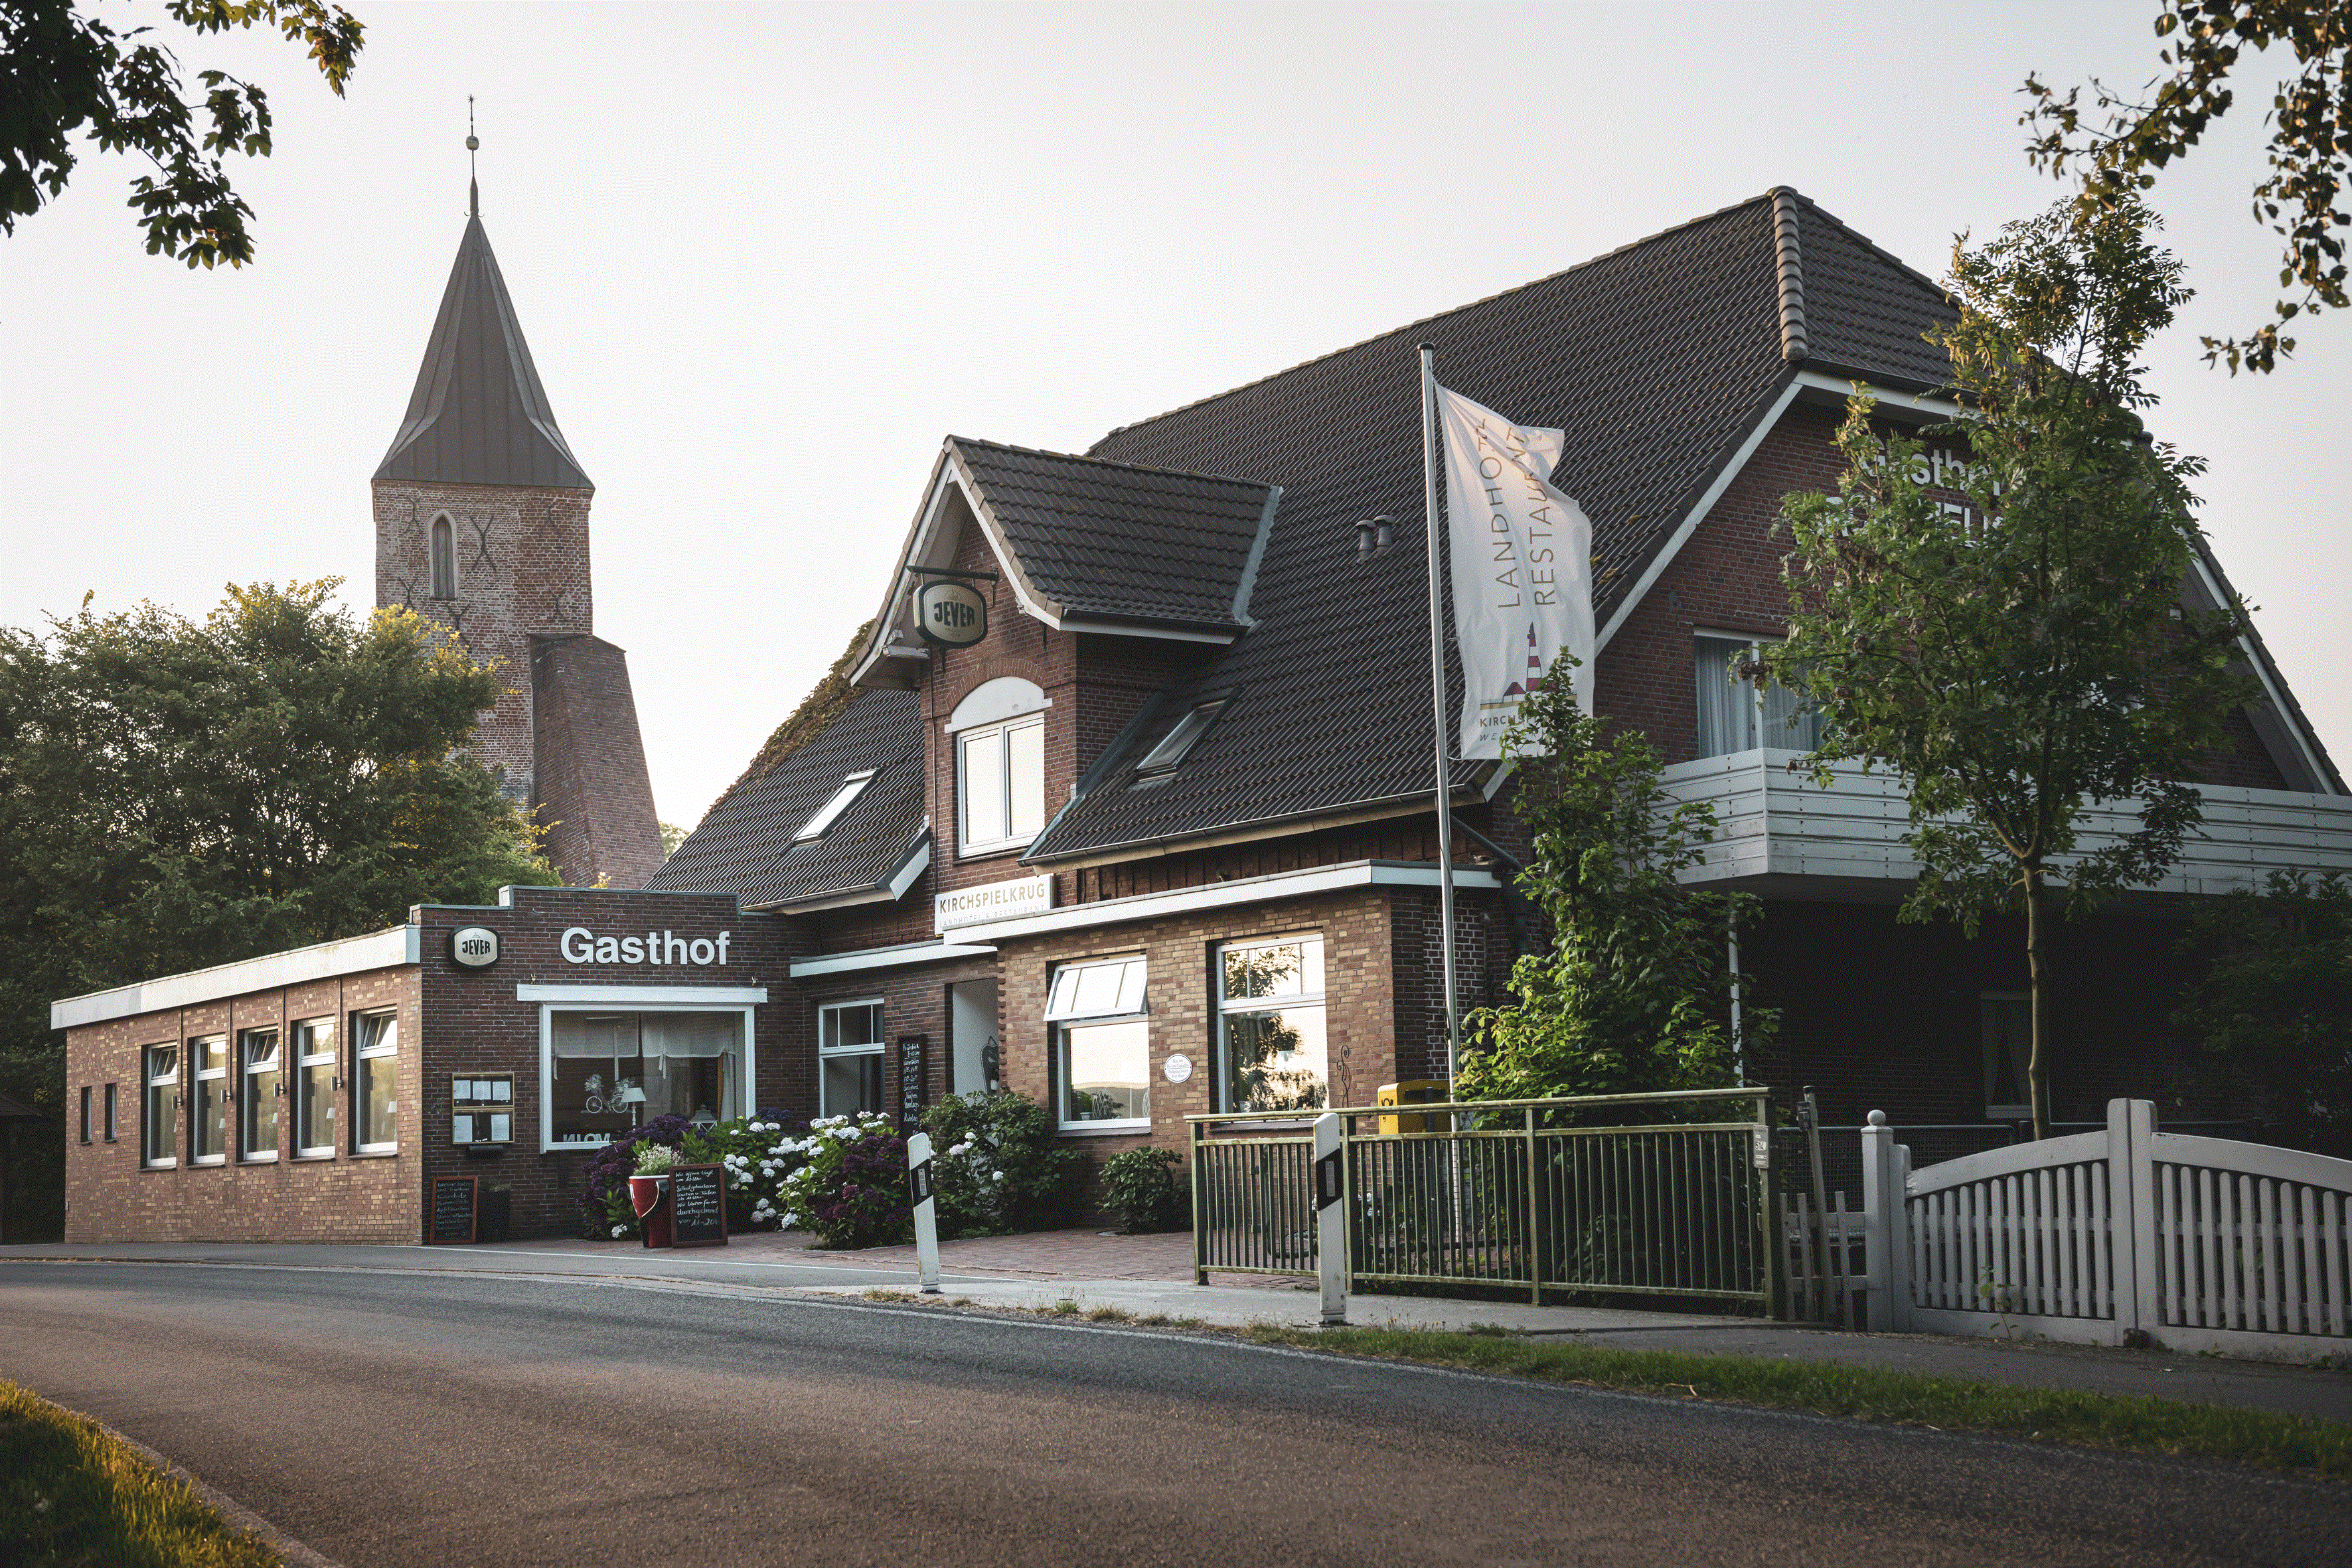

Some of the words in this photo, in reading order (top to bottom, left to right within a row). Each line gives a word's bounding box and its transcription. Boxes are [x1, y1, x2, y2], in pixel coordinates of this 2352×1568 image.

[933, 601, 975, 627] JEVER
[940, 882, 1045, 914] KIRCHSPIELKRUG
[462, 939, 491, 955] JEVER
[560, 927, 730, 965] Gasthof
[676, 1206, 718, 1218] durchgehend
